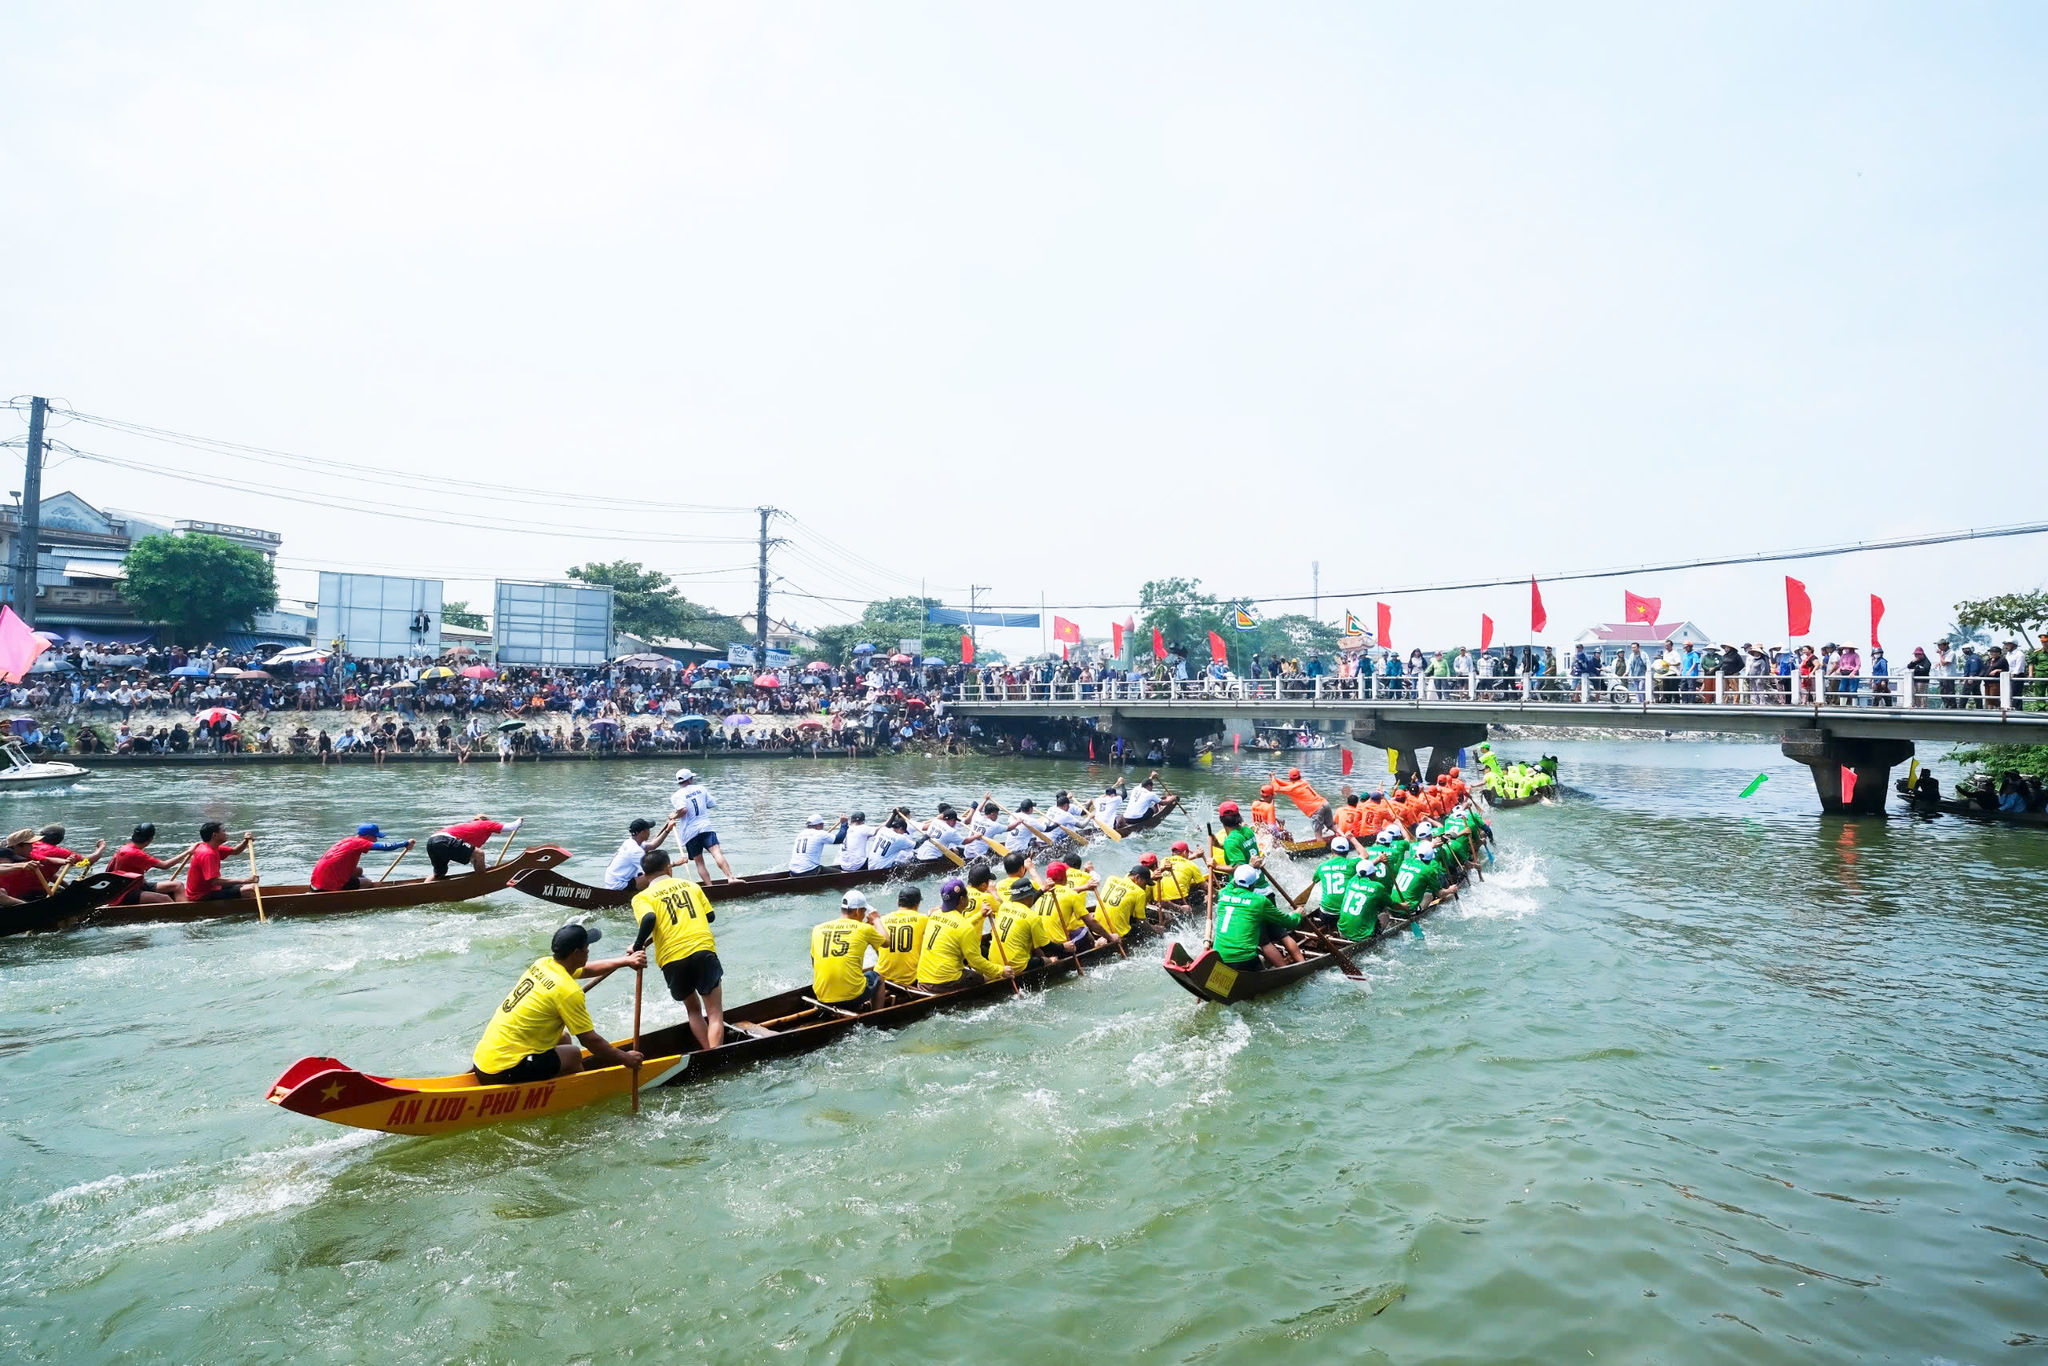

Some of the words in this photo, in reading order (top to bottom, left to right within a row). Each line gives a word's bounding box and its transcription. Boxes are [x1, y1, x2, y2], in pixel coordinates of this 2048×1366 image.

[874, 836, 892, 856] 14
[1102, 883, 1126, 906] 13
[1324, 872, 1344, 894] 12
[661, 890, 696, 925] 14
[1343, 889, 1367, 916] 13
[888, 925, 914, 952] 10
[1000, 915, 1014, 942] 4
[822, 930, 852, 958] 15
[502, 978, 534, 1013] 9
[387, 1099, 422, 1126] AN
